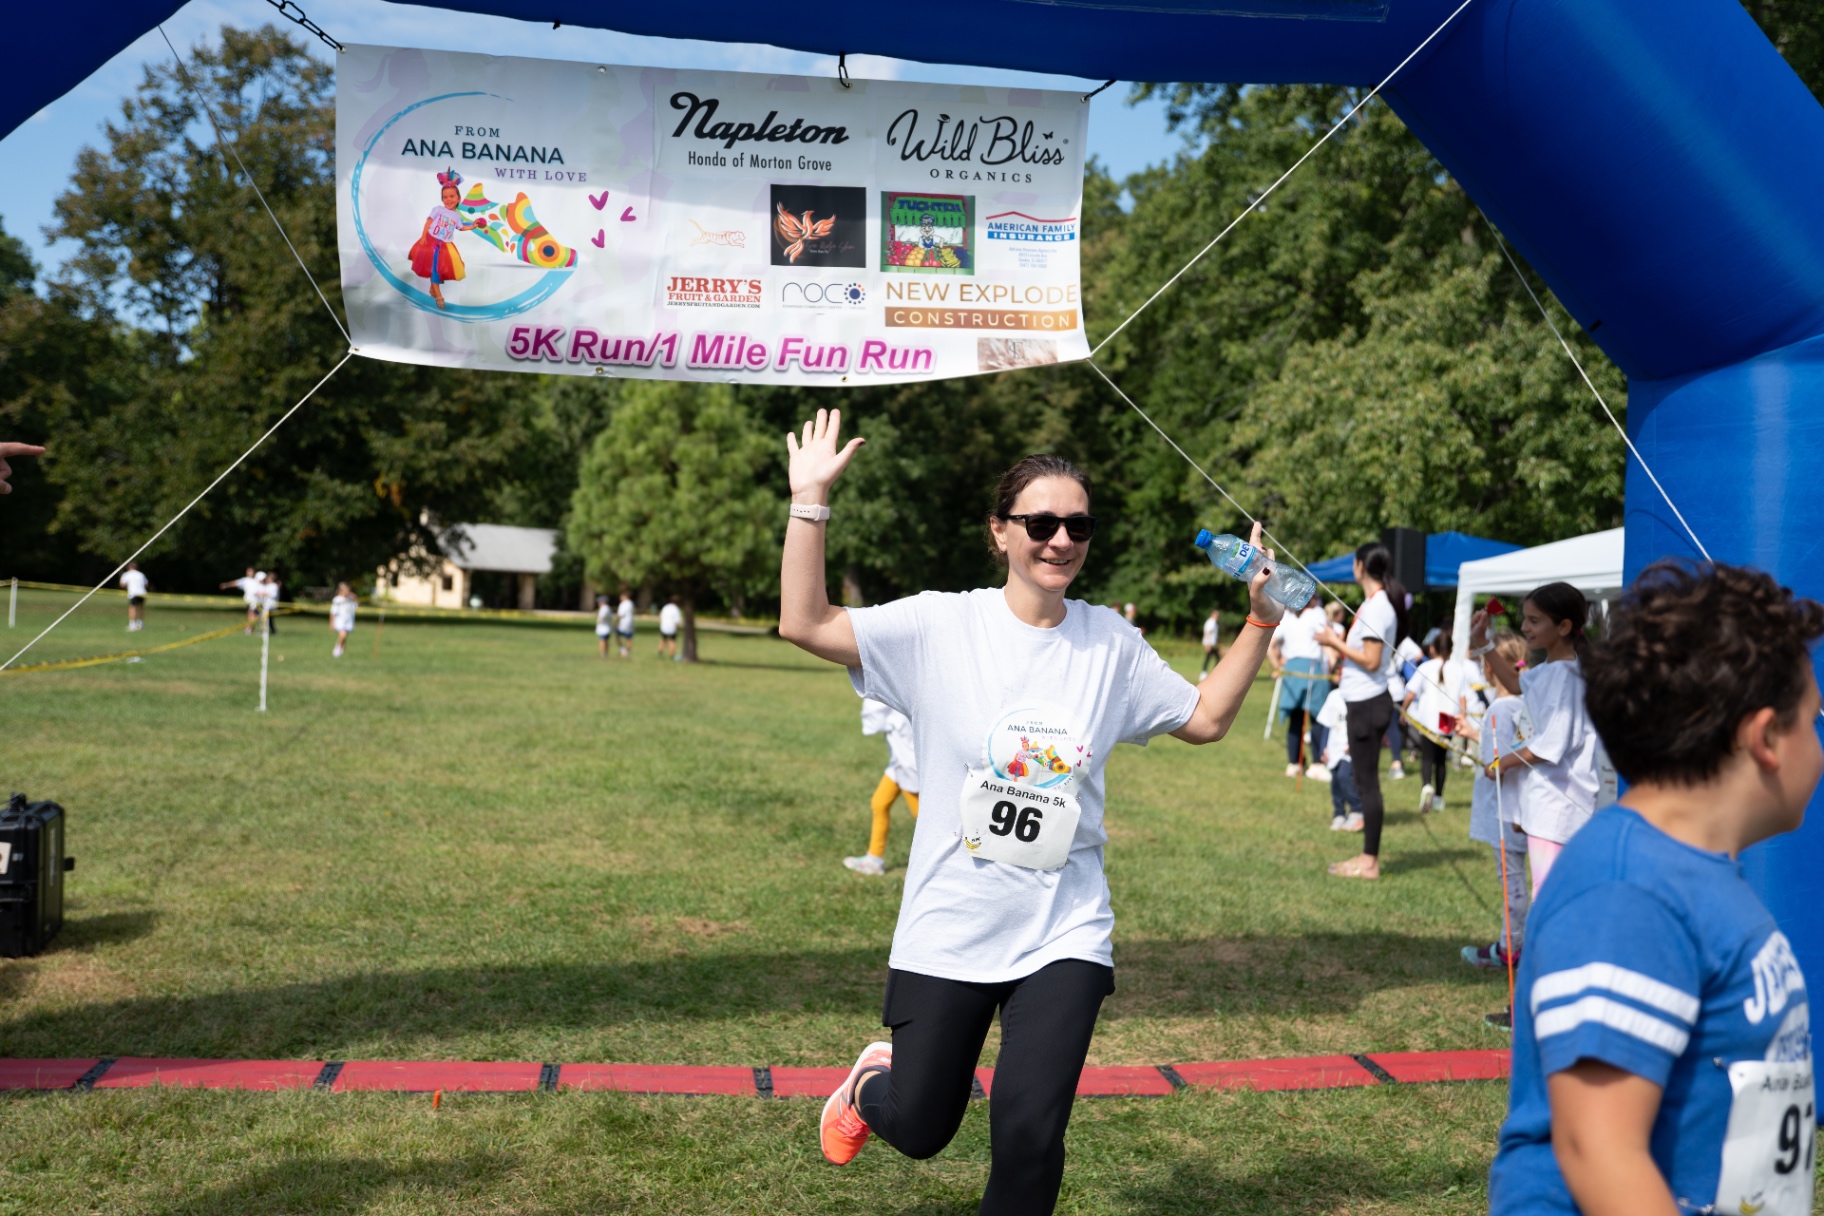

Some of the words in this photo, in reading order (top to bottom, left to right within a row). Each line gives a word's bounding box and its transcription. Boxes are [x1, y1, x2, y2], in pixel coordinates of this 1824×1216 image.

[669, 91, 850, 149] Napleton
[454, 125, 500, 138] FROM
[886, 108, 979, 161] Wild
[401, 138, 455, 159] ANA
[461, 141, 565, 165] BANANA
[688, 150, 727, 167] Honda
[732, 152, 745, 168] of
[750, 154, 792, 170] Morton
[798, 155, 832, 171] Grove
[494, 167, 537, 180] WITH
[544, 170, 587, 183] LOVE
[929, 168, 1033, 184] ORGANICS
[987, 222, 1039, 233] AMERICAN
[1042, 223, 1076, 233] FAMILY
[993, 232, 1071, 241] INSURANCE
[666, 276, 762, 295] JERRY'S
[886, 281, 951, 301] NEW
[959, 283, 1078, 305] EXPLODE
[668, 292, 703, 302] FRUIT
[704, 294, 712, 302] &
[713, 294, 761, 303] GARDEN
[893, 310, 1071, 328] CONSTRUCTION
[509, 327, 564, 357] 5K
[571, 330, 678, 364] Run/1
[691, 334, 767, 367] Mile
[777, 337, 848, 369] Fun
[860, 340, 933, 370] Run
[1007, 724, 1027, 732] ANA
[1029, 726, 1068, 735] BANANA
[980, 780, 1004, 793] Ana
[1006, 786, 1050, 804] Banana
[1052, 796, 1067, 809] 5k
[988, 800, 1044, 843] 96
